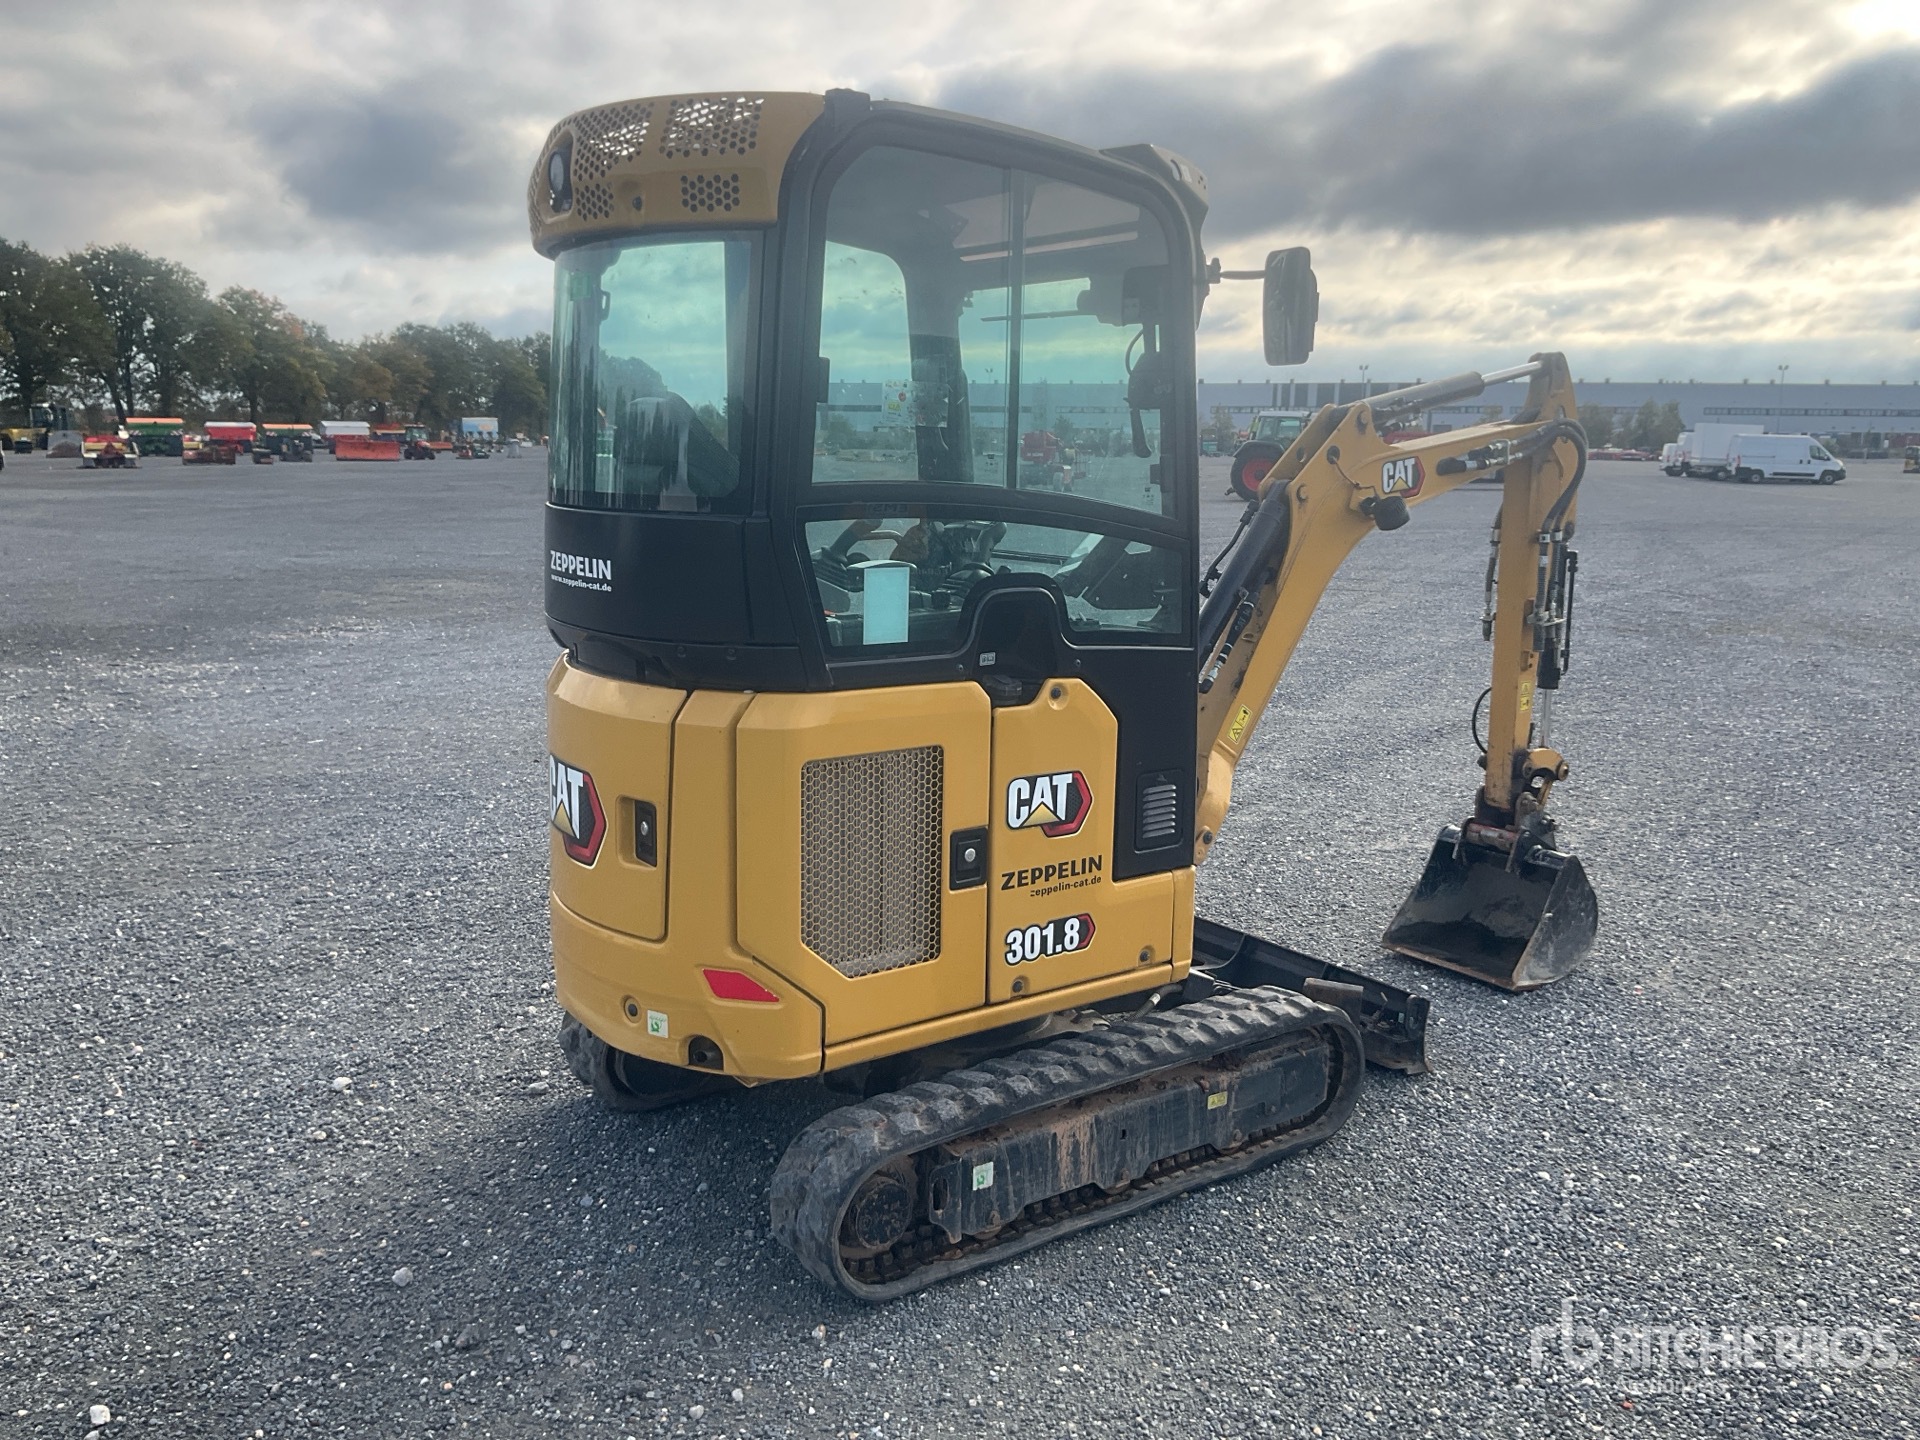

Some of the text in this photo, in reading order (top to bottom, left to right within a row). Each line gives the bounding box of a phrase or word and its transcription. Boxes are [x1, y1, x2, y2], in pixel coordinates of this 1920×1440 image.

[1383, 458, 1415, 493] CAT
[550, 550, 612, 580] ZEPPELIN
[1008, 773, 1073, 828] CAT
[1001, 855, 1102, 890] ZEPPELIN
[1030, 875, 1102, 897] zeppelin-cat.de
[1006, 917, 1080, 964] 301.8
